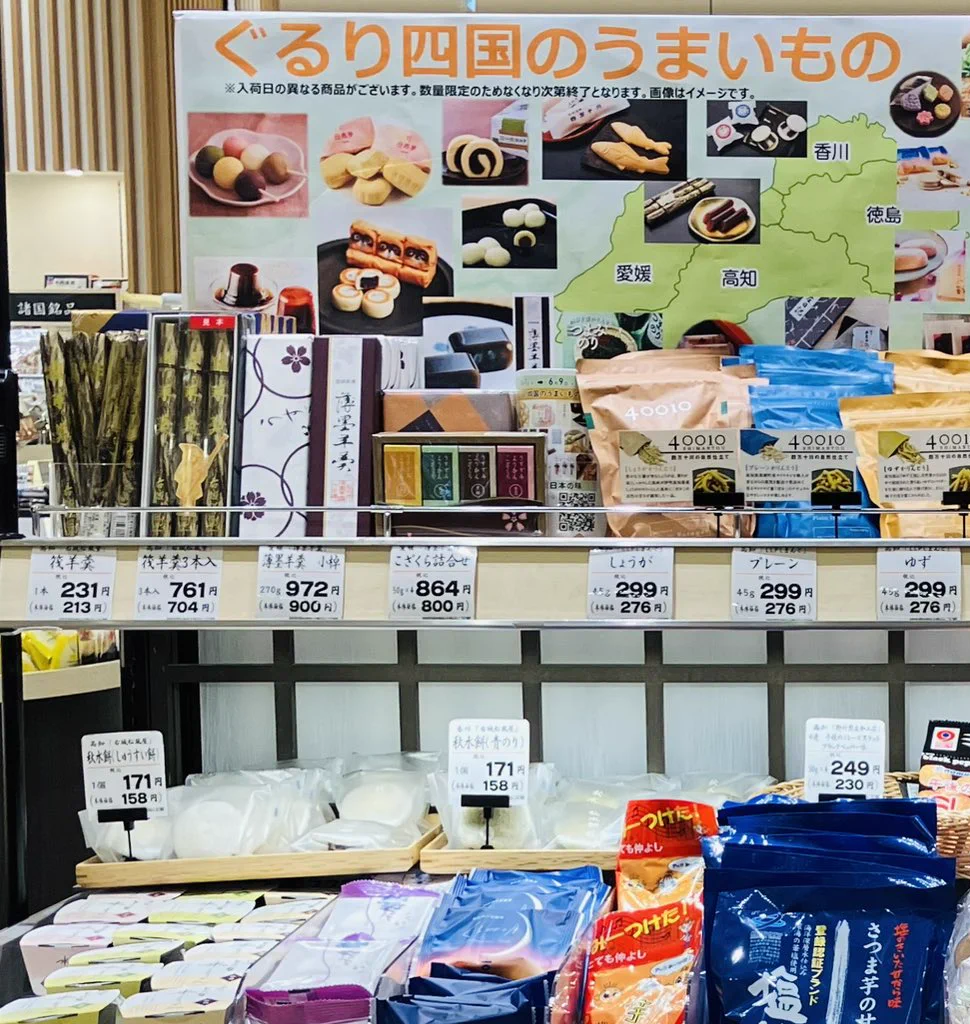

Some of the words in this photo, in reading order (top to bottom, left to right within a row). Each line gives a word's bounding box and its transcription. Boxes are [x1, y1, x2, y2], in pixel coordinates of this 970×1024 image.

[214, 20, 900, 82] ぐるり四国のうまいもの
[814, 142, 849, 162] 香川
[867, 206, 902, 225] 徳島
[616, 265, 651, 283] 愛媛
[722, 269, 757, 288] 高知
[201, 317, 225, 327] 見本
[576, 337, 600, 352] のり
[624, 400, 693, 421] 40010
[668, 434, 726, 451] 40010
[788, 434, 847, 450] 40010
[609, 555, 654, 569] しょうが
[750, 557, 800, 570] プレーン
[904, 555, 932, 569] ゆず
